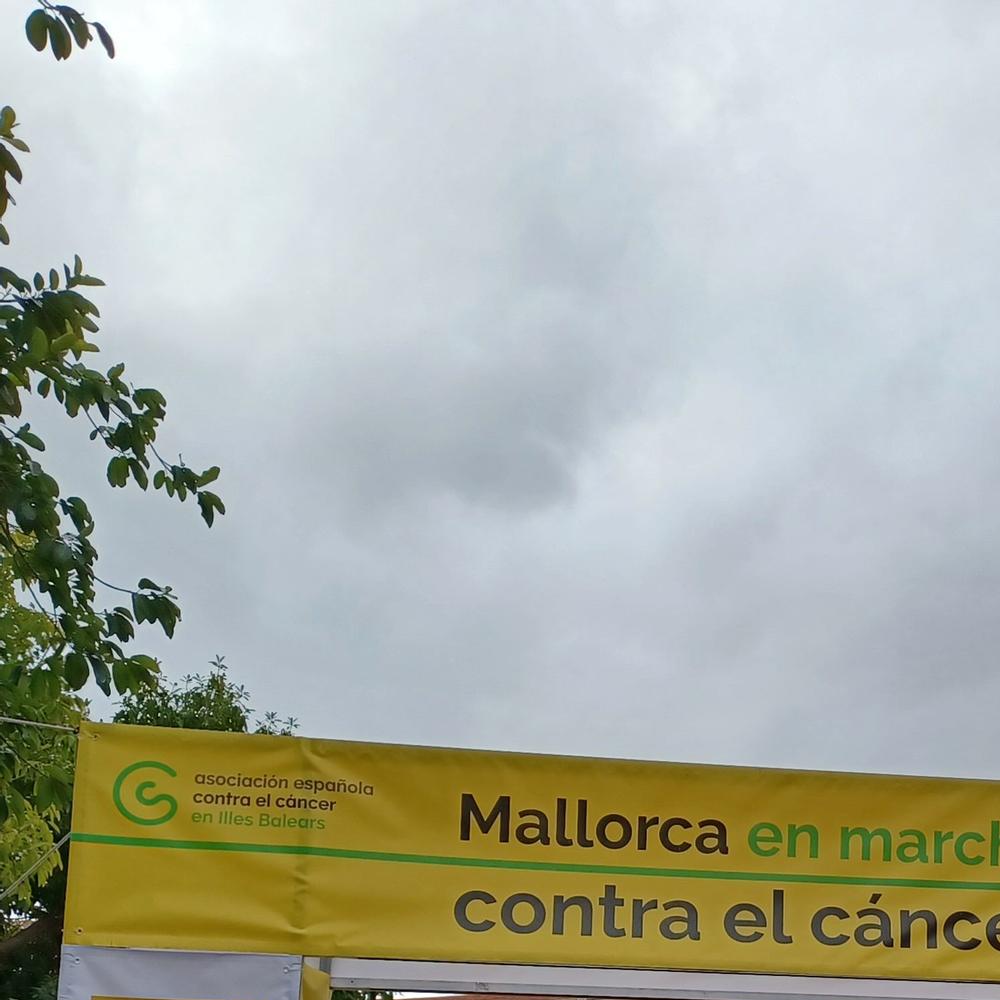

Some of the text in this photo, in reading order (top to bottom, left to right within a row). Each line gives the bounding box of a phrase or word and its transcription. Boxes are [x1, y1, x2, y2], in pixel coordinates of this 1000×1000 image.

[194, 771, 374, 797] asociación española
[192, 790, 336, 812] contra el cáncer
[192, 809, 326, 830] en Illes Balears
[459, 793, 729, 855] Mallorca
[748, 821, 819, 858] en
[453, 884, 701, 941] contra
[723, 889, 793, 945] el
